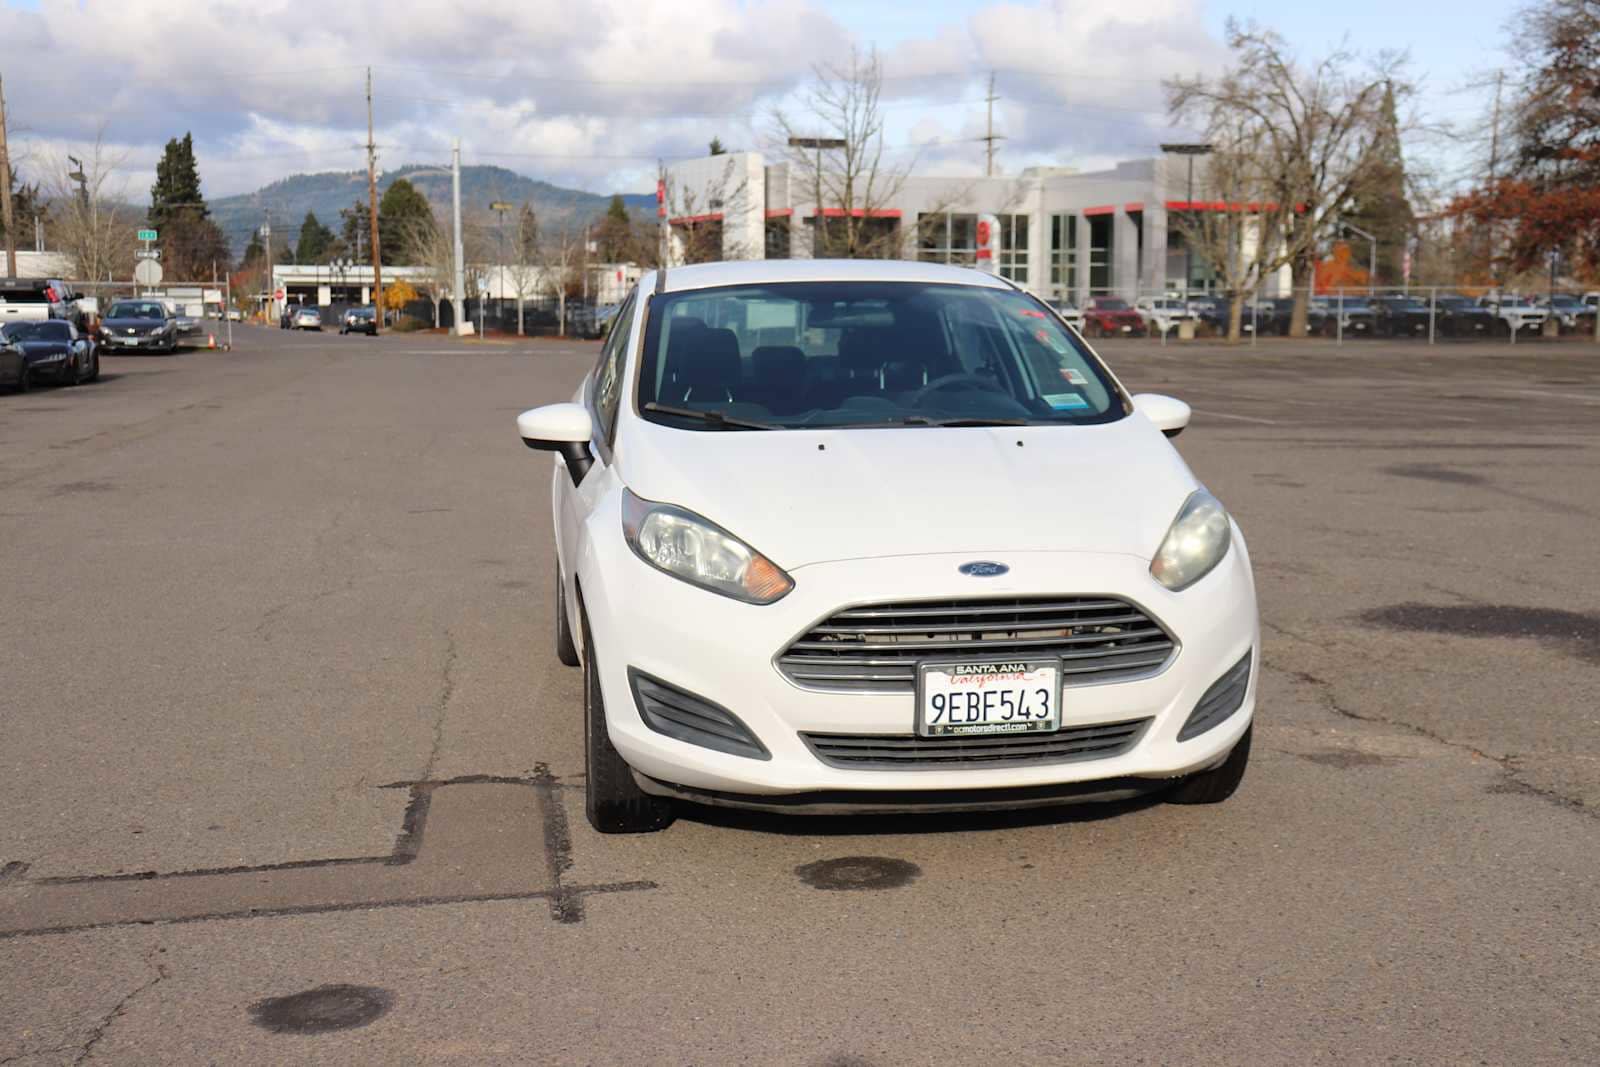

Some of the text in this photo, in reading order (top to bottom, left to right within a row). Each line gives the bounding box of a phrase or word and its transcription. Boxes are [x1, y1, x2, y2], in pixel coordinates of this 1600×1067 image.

[956, 663, 1026, 675] SANTA ANA
[931, 688, 1049, 723] 9EBF543
